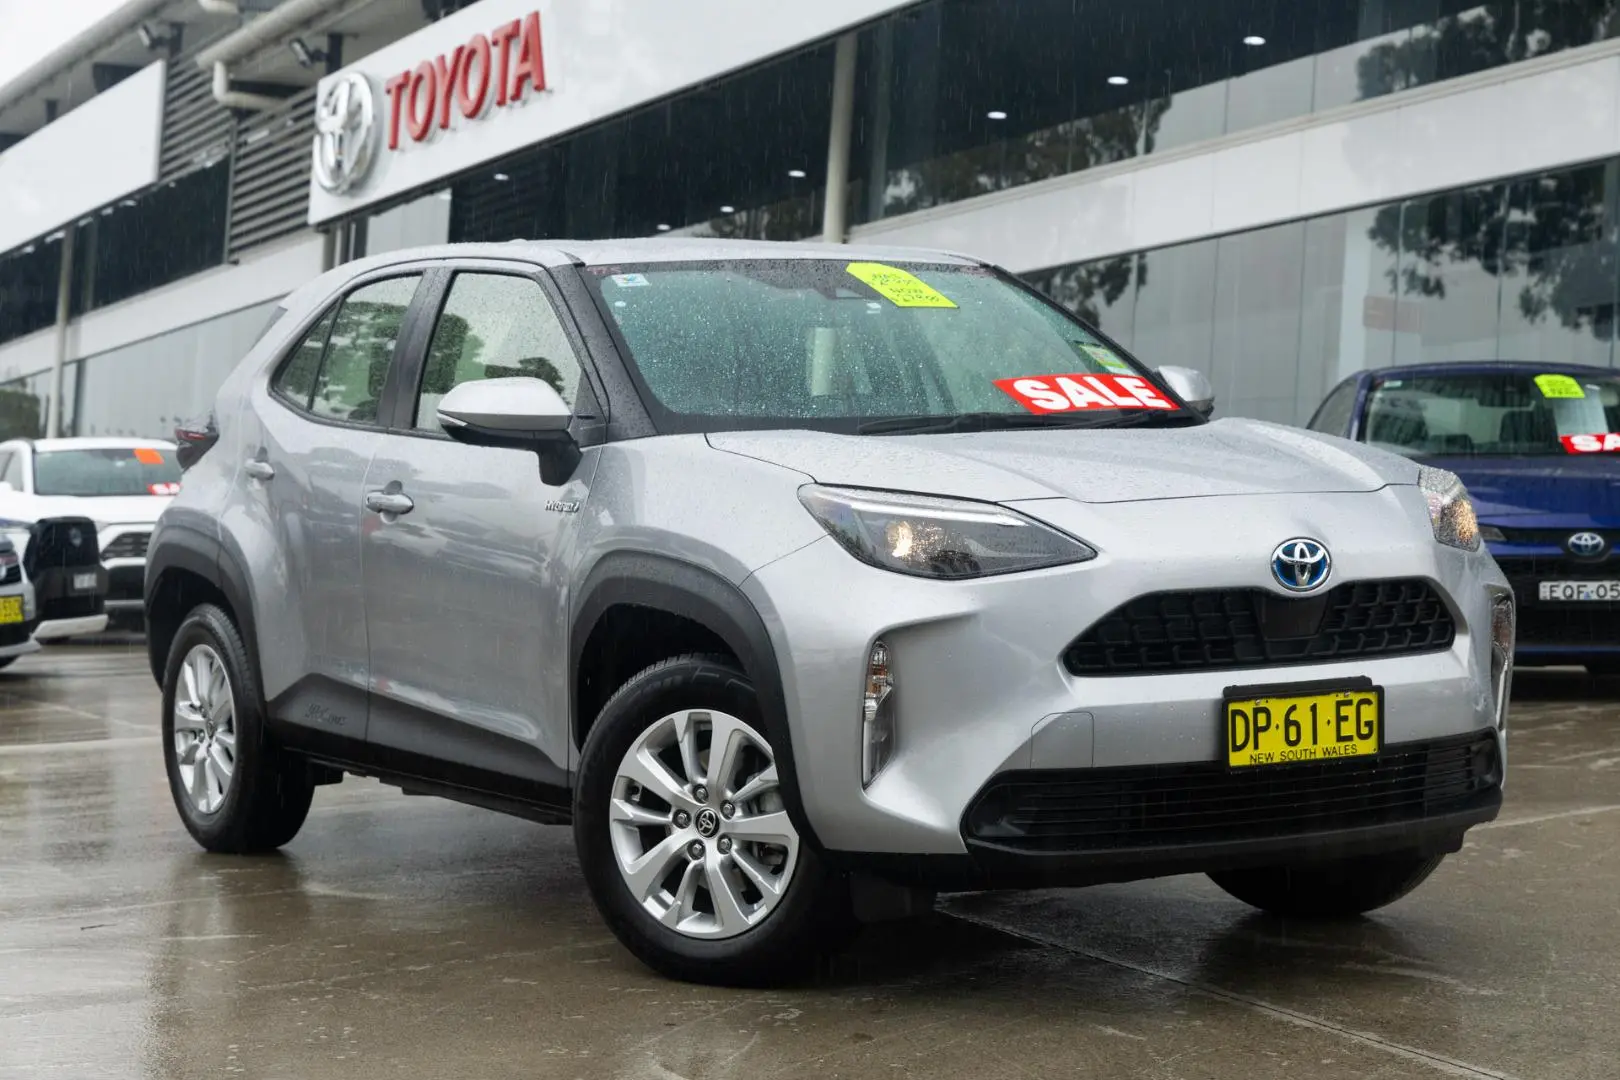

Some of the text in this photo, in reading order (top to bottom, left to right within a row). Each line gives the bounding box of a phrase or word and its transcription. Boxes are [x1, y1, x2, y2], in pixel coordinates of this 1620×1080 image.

[385, 10, 546, 151] TOYOTA
[1013, 376, 1172, 410] SALE
[1250, 744, 1358, 765] NEW SOUTH WALES
